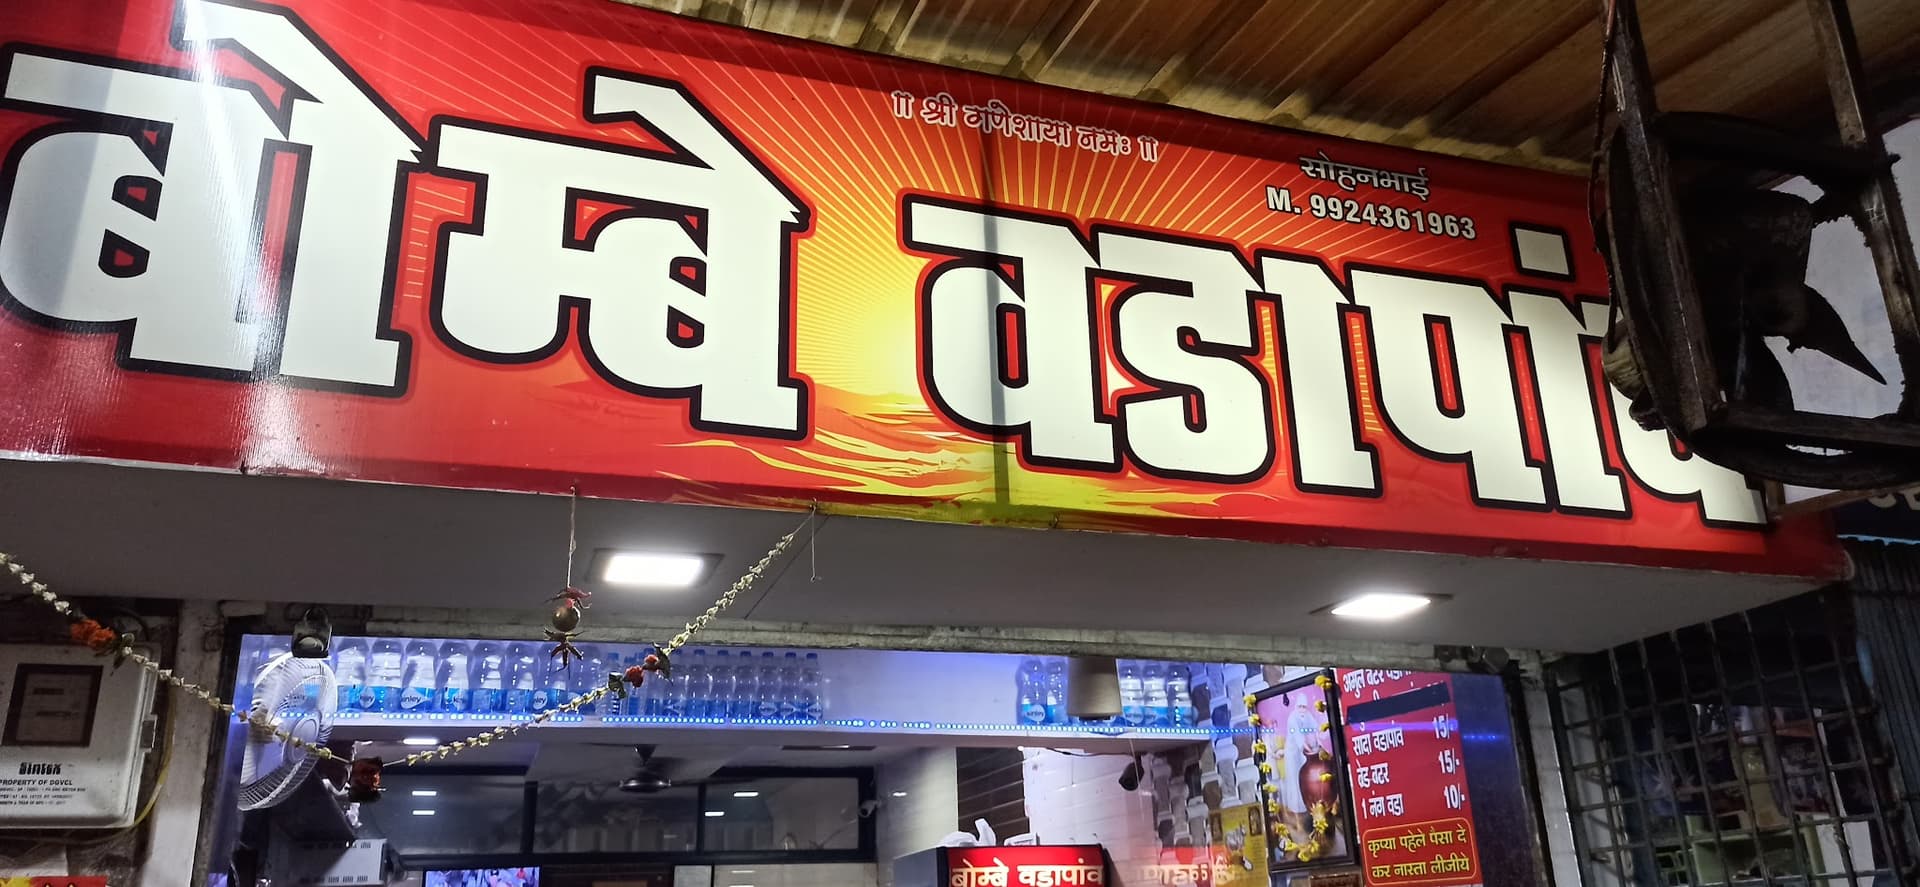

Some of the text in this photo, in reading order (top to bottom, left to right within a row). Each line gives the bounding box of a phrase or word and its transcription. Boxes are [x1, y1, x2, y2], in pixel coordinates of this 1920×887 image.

[920, 92, 958, 128] श्री
[1076, 125, 1132, 156] नमः
[1299, 151, 1430, 201] सोहनभाई
[0, 0, 808, 438] बोम्बे
[1265, 185, 1477, 240] M. 9924361963
[1352, 733, 1372, 756] सादा
[1438, 747, 1460, 775] 15/-
[1362, 798, 1368, 819] 1
[1443, 783, 1466, 810] 10/-
[1430, 825, 1453, 845] पैसा
[1456, 823, 1467, 844] दे
[951, 857, 1009, 887] बोम्बे
[1372, 865, 1391, 879] कर
